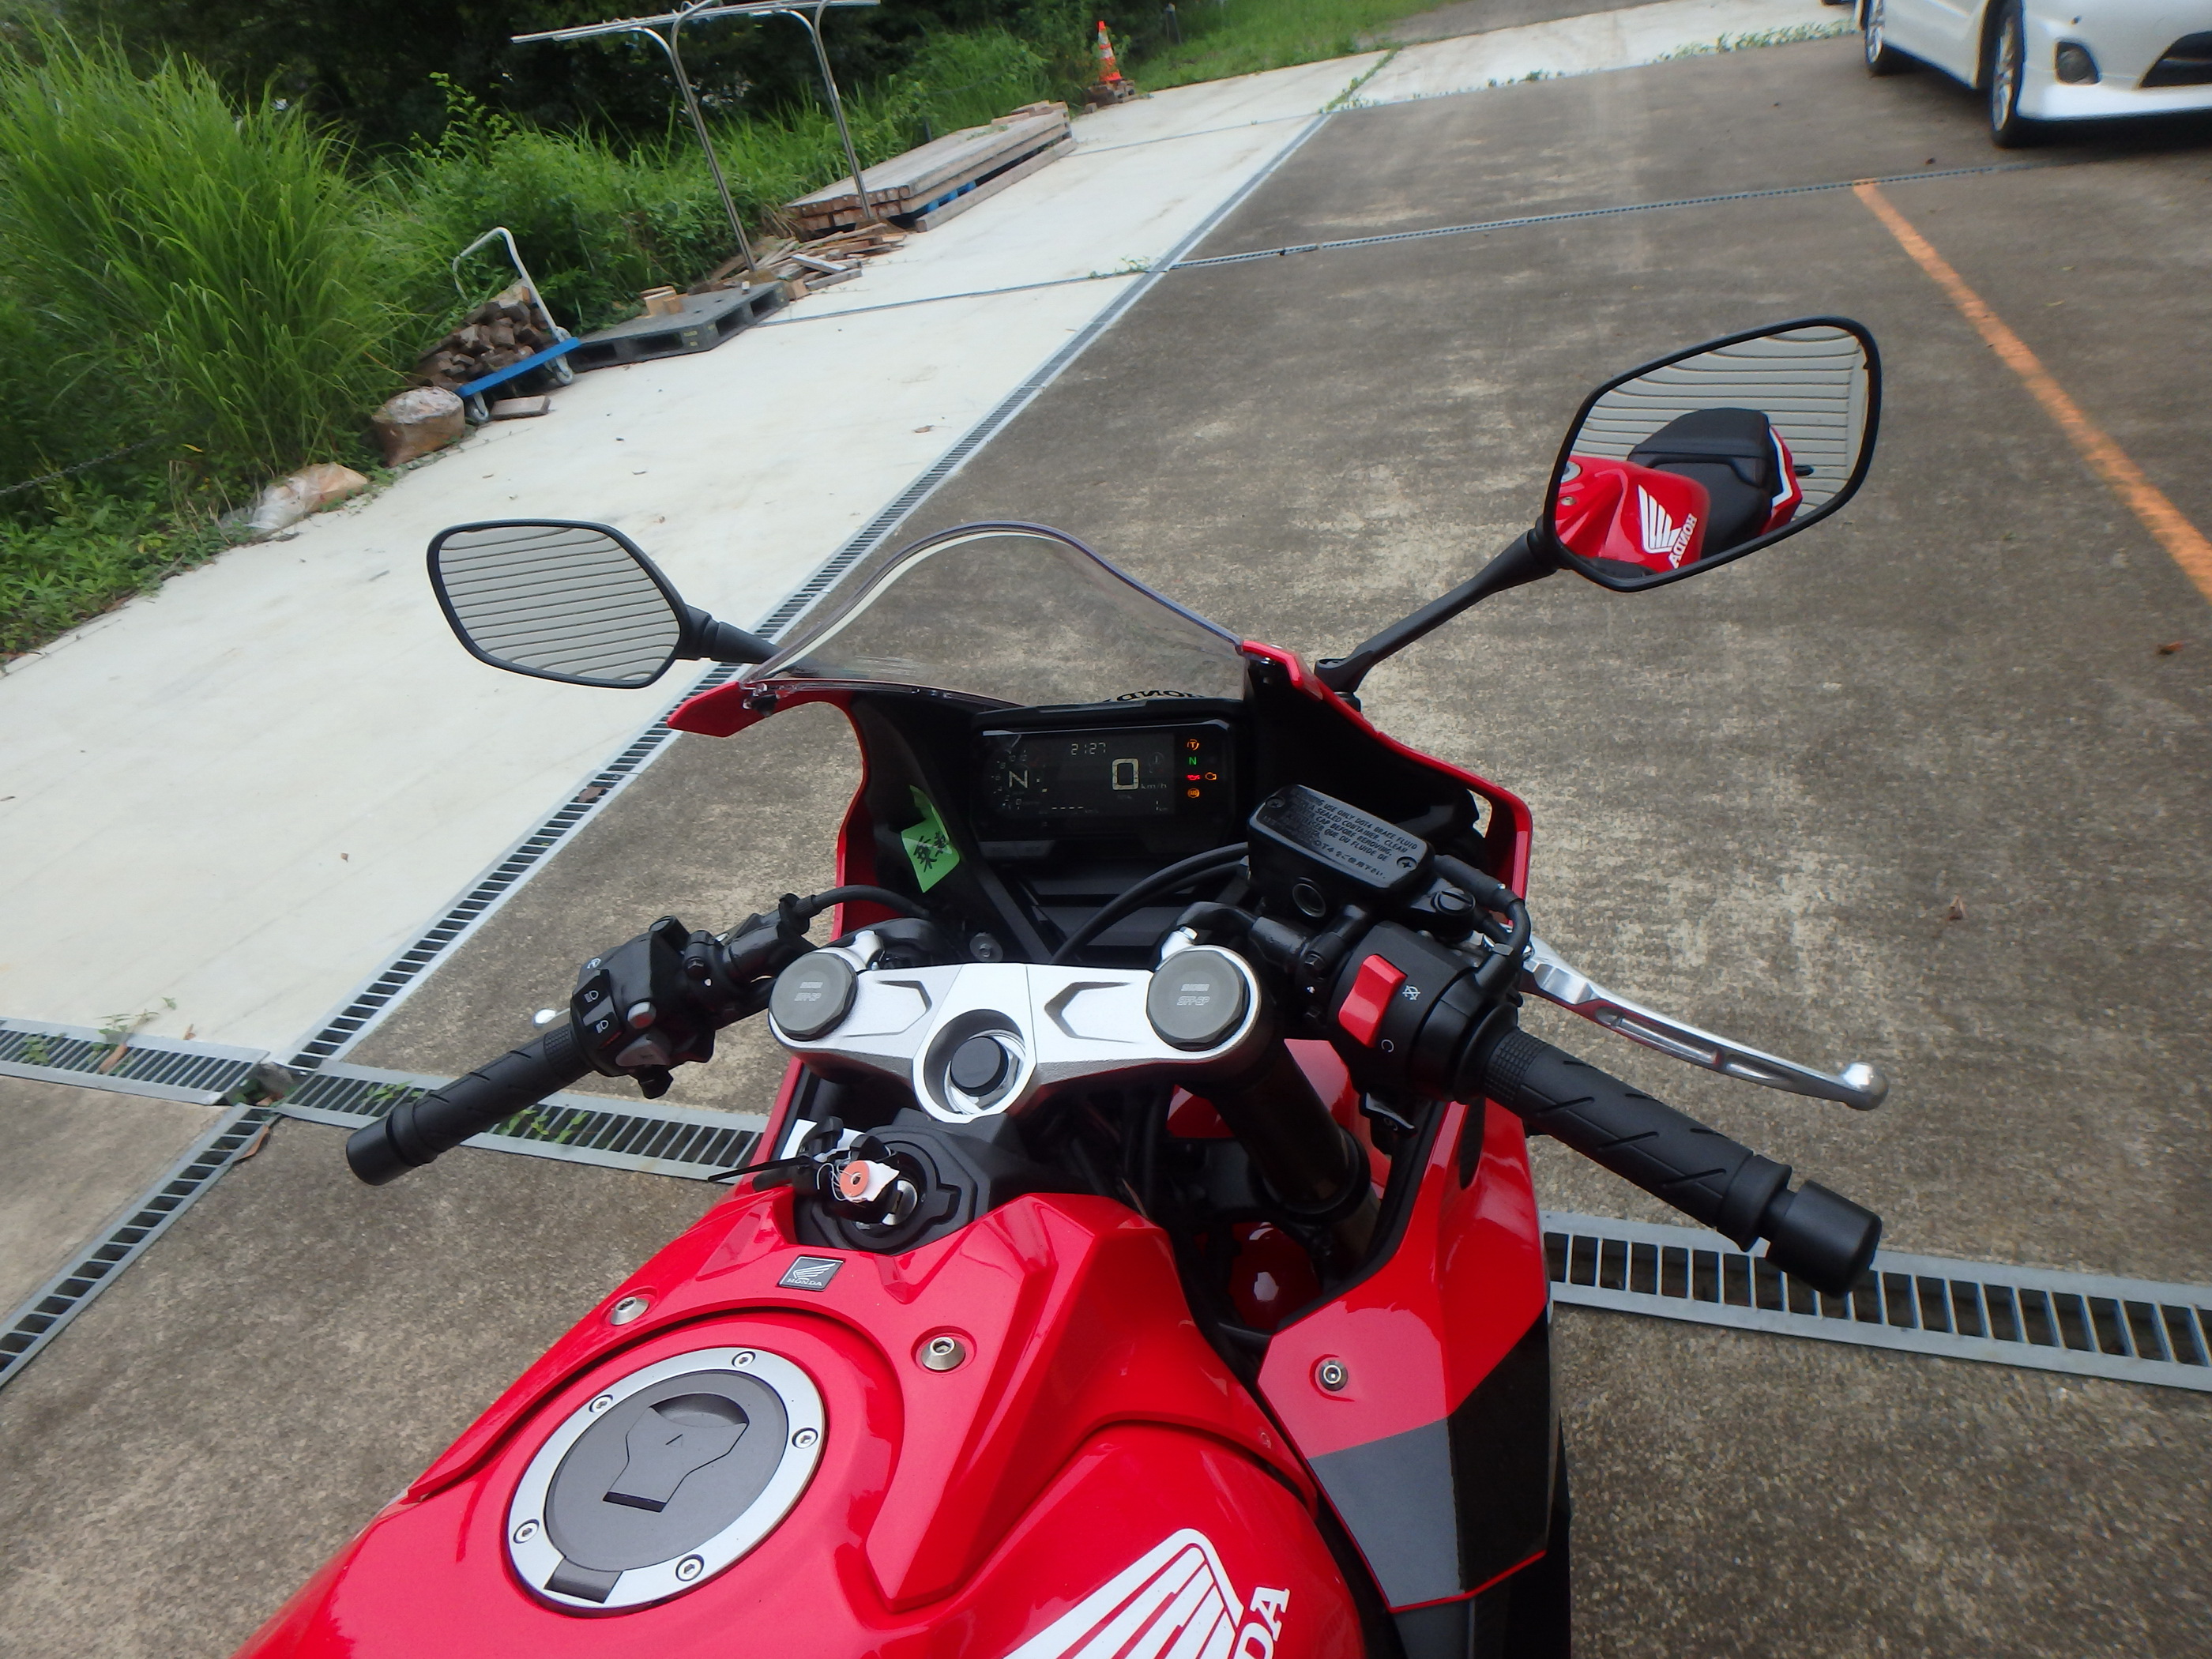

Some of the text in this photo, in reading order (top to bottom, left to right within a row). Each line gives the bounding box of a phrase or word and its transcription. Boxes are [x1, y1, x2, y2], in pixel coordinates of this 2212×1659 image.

[1189, 756, 1197, 766] N
[1008, 769, 1029, 788] N
[1315, 808, 1341, 822] SEALED
[1316, 816, 1330, 826] CAP
[1330, 823, 1356, 837] BEFORE
[1324, 803, 1337, 812] USE
[1337, 810, 1354, 821] ONLY
[1396, 837, 1417, 849] FLUID
[1324, 829, 1338, 838] QUE
[1351, 841, 1376, 856] FLUIDE
[786, 1277, 822, 1286] HONDA
